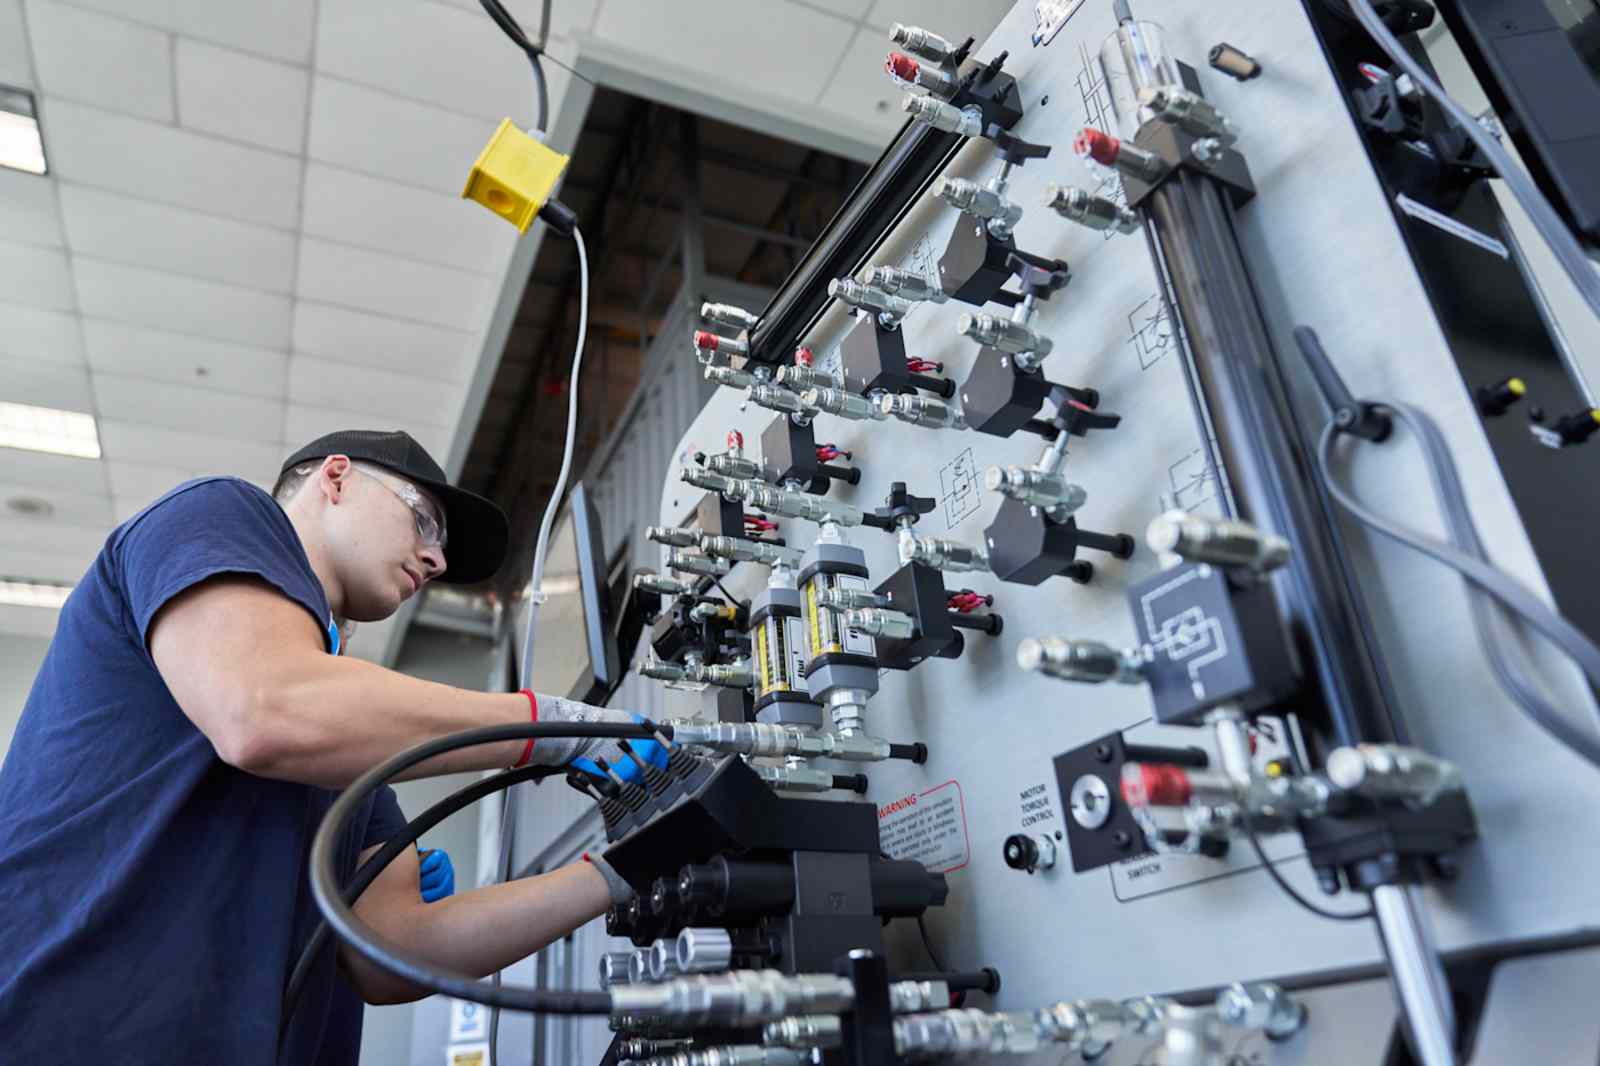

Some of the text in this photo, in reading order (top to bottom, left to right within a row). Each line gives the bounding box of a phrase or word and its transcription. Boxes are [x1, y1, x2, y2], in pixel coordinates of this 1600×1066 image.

[1019, 783, 1046, 799] MOTOR
[879, 793, 917, 818] WARNING
[1020, 796, 1050, 814] TORQUE
[1021, 809, 1054, 828] CONTROL
[1127, 863, 1161, 880] SWITCH
